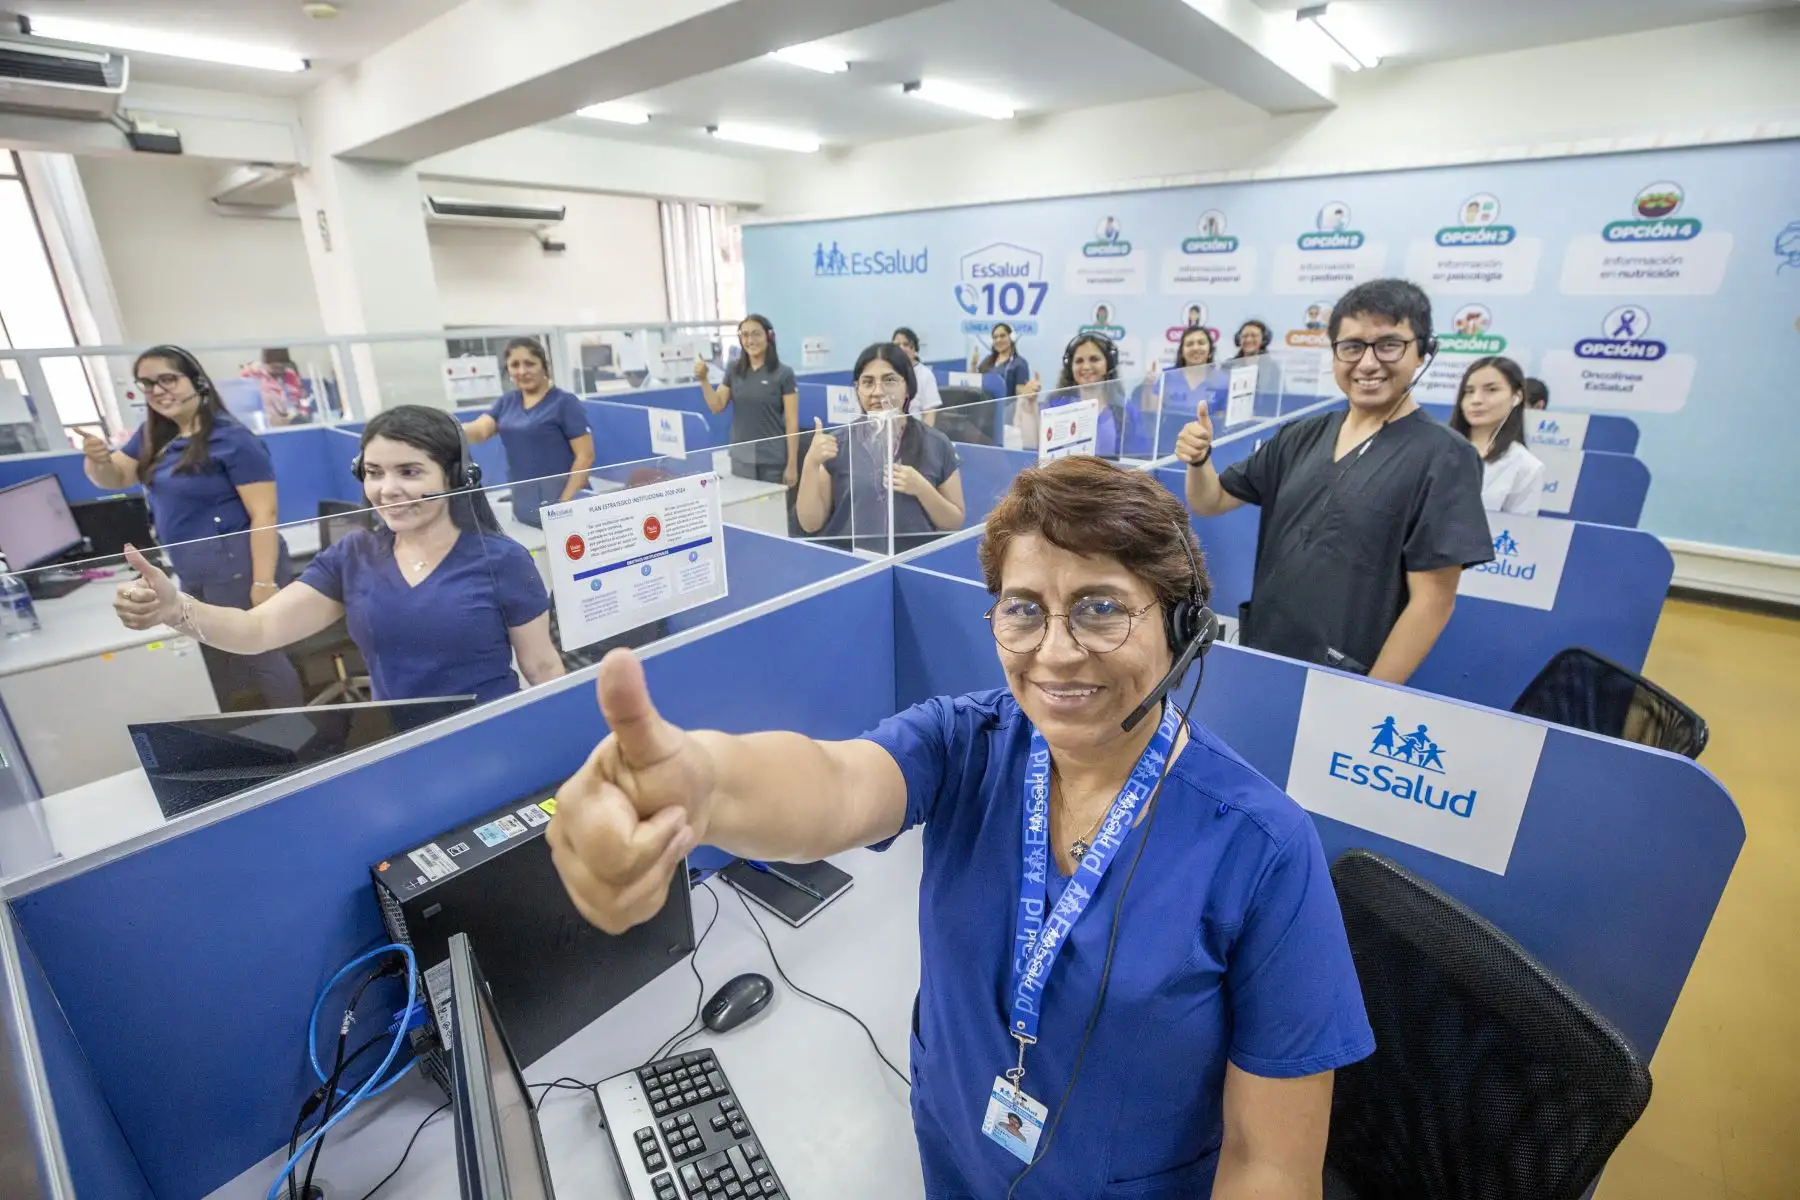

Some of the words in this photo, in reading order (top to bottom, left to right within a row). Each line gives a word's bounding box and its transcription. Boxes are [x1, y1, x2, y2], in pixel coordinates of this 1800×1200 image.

[1441, 228, 1493, 244] OPCIÓN
[1609, 222, 1677, 239] OPCIÓN
[1679, 224, 1693, 236] 4
[1302, 233, 1347, 248] OPCIÓN
[851, 243, 928, 275] EsSalud
[971, 260, 1030, 279] EsSalud
[1618, 269, 1680, 279] nutrición
[982, 281, 1049, 316] 107
[1581, 341, 1645, 357] OPCIÓN
[1645, 345, 1659, 357] 9
[1474, 560, 1537, 580] Salud
[1329, 751, 1477, 818] EsSalud
